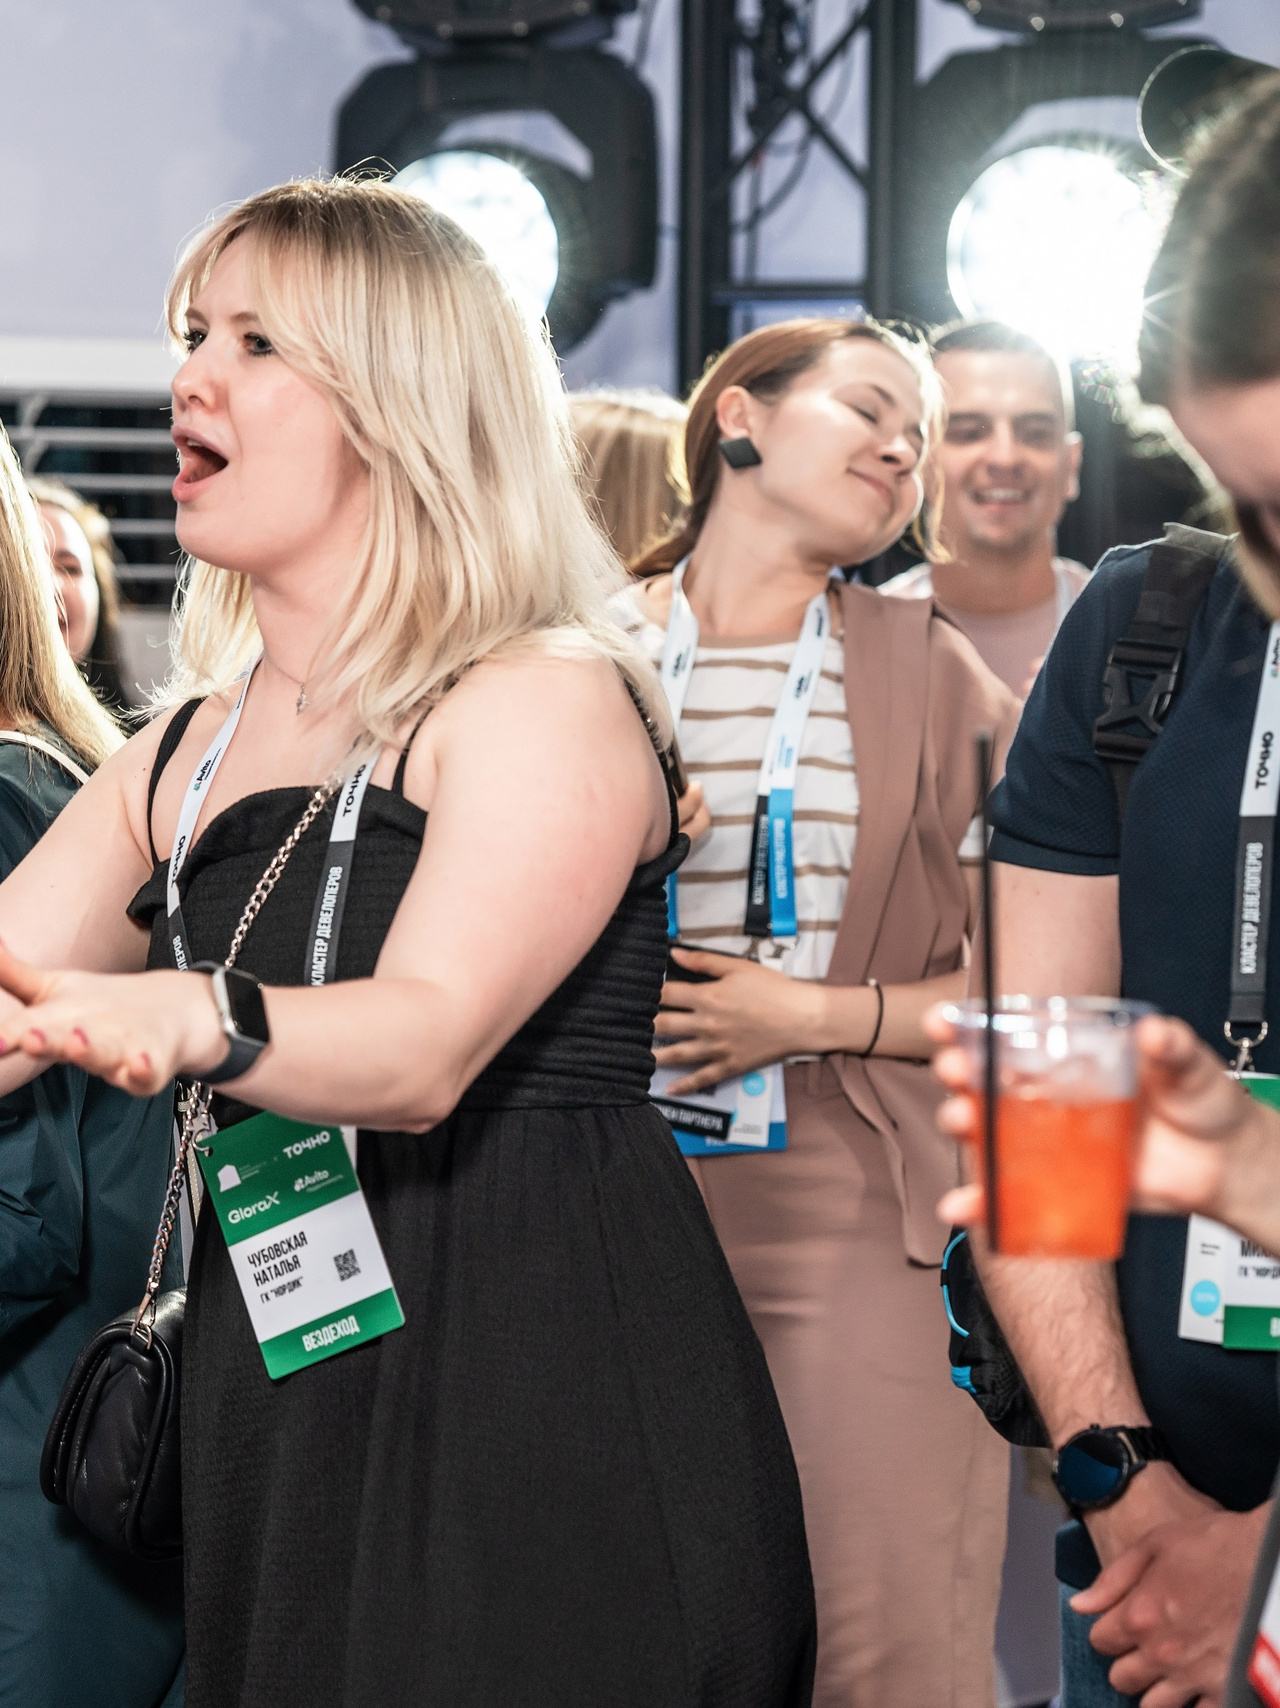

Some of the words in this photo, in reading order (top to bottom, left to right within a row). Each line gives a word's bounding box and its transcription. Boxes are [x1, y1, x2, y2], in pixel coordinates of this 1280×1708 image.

[1255, 731, 1274, 789] ТОЧНО
[343, 764, 367, 817] ТОЧНО
[171, 835, 186, 888] ТОЧНО
[316, 866, 343, 939] ДЕВЕЛОПЕРОВ
[311, 938, 329, 986] КЛАСТЕР
[1240, 922, 1258, 974] КЛАСТЕР
[283, 1131, 330, 1159] ТОЧНО
[228, 1191, 280, 1224] GloraX
[247, 1231, 308, 1267] ЧУБОВСКАЯ
[253, 1254, 301, 1287] НАТАЛЬЯ
[260, 1292, 270, 1304] ГК
[302, 1315, 360, 1352] ВЕЗДЕХОД
